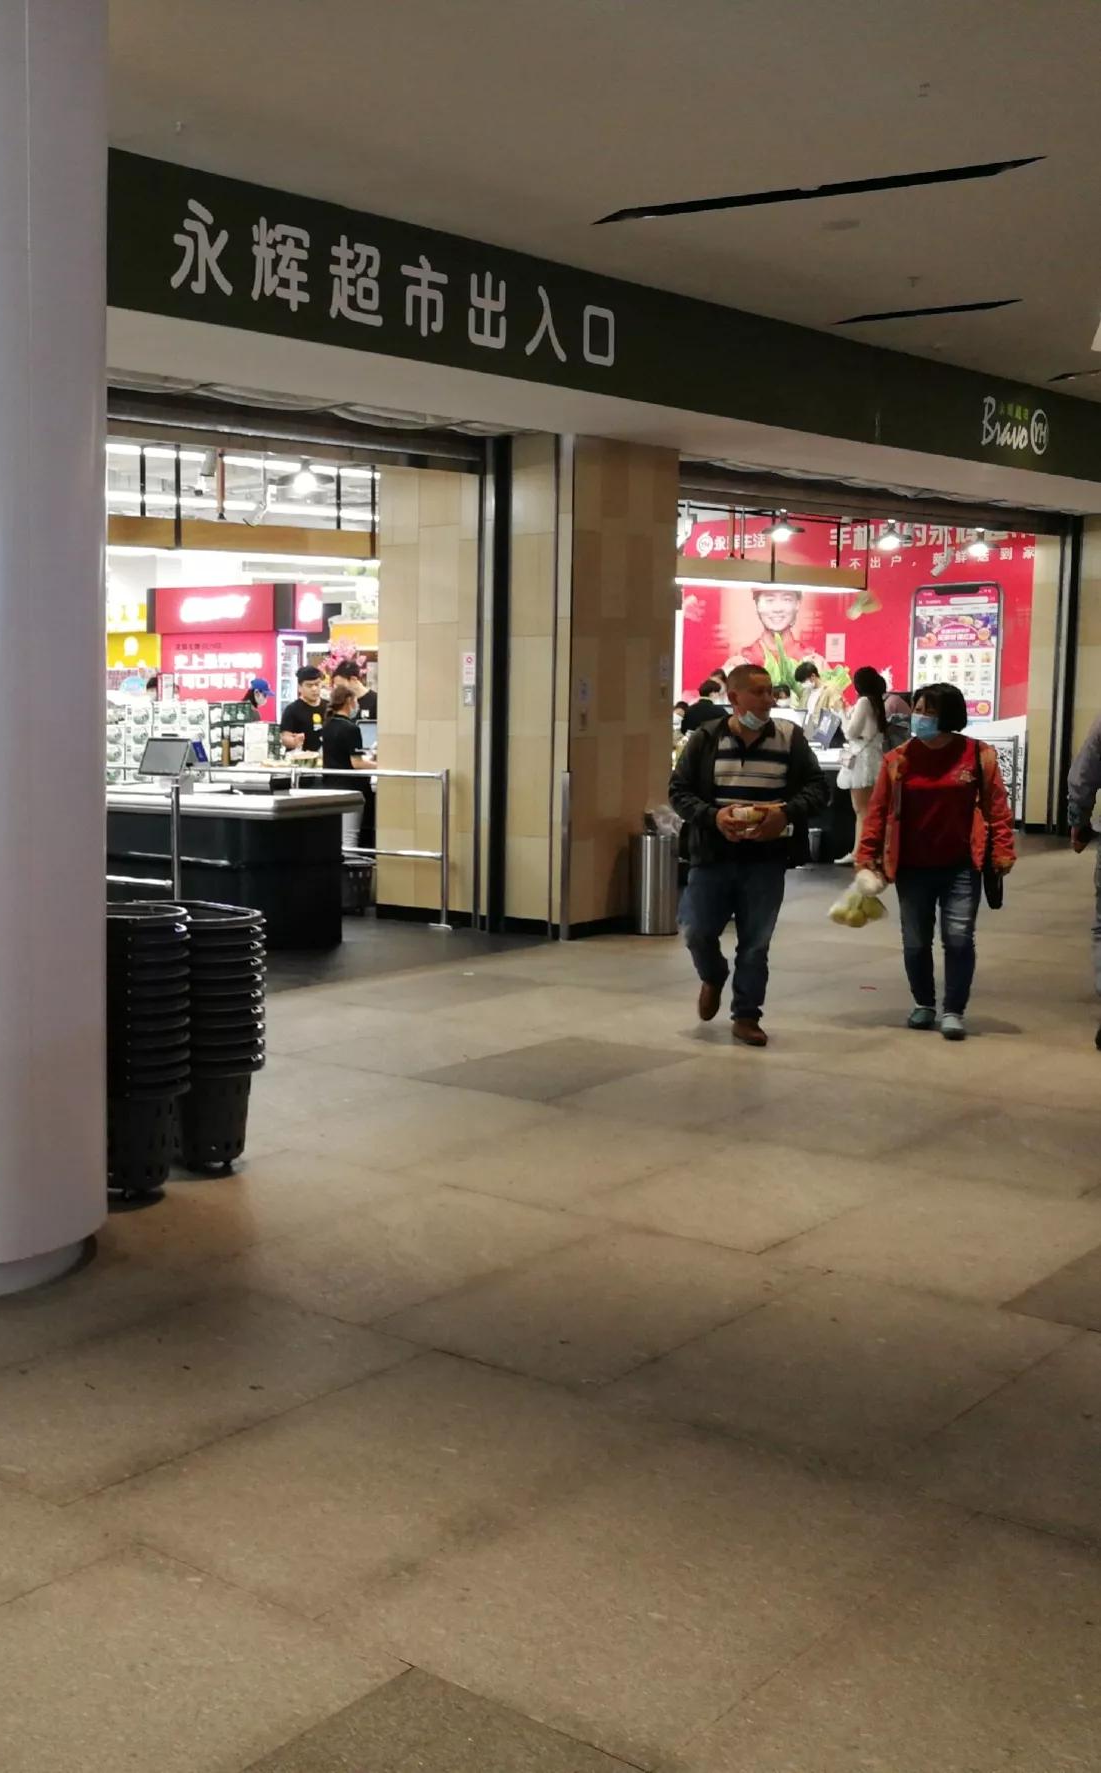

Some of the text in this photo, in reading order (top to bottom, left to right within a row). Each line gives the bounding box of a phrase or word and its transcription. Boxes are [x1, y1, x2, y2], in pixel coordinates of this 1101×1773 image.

[170, 198, 615, 367] 永辉超市出入口
